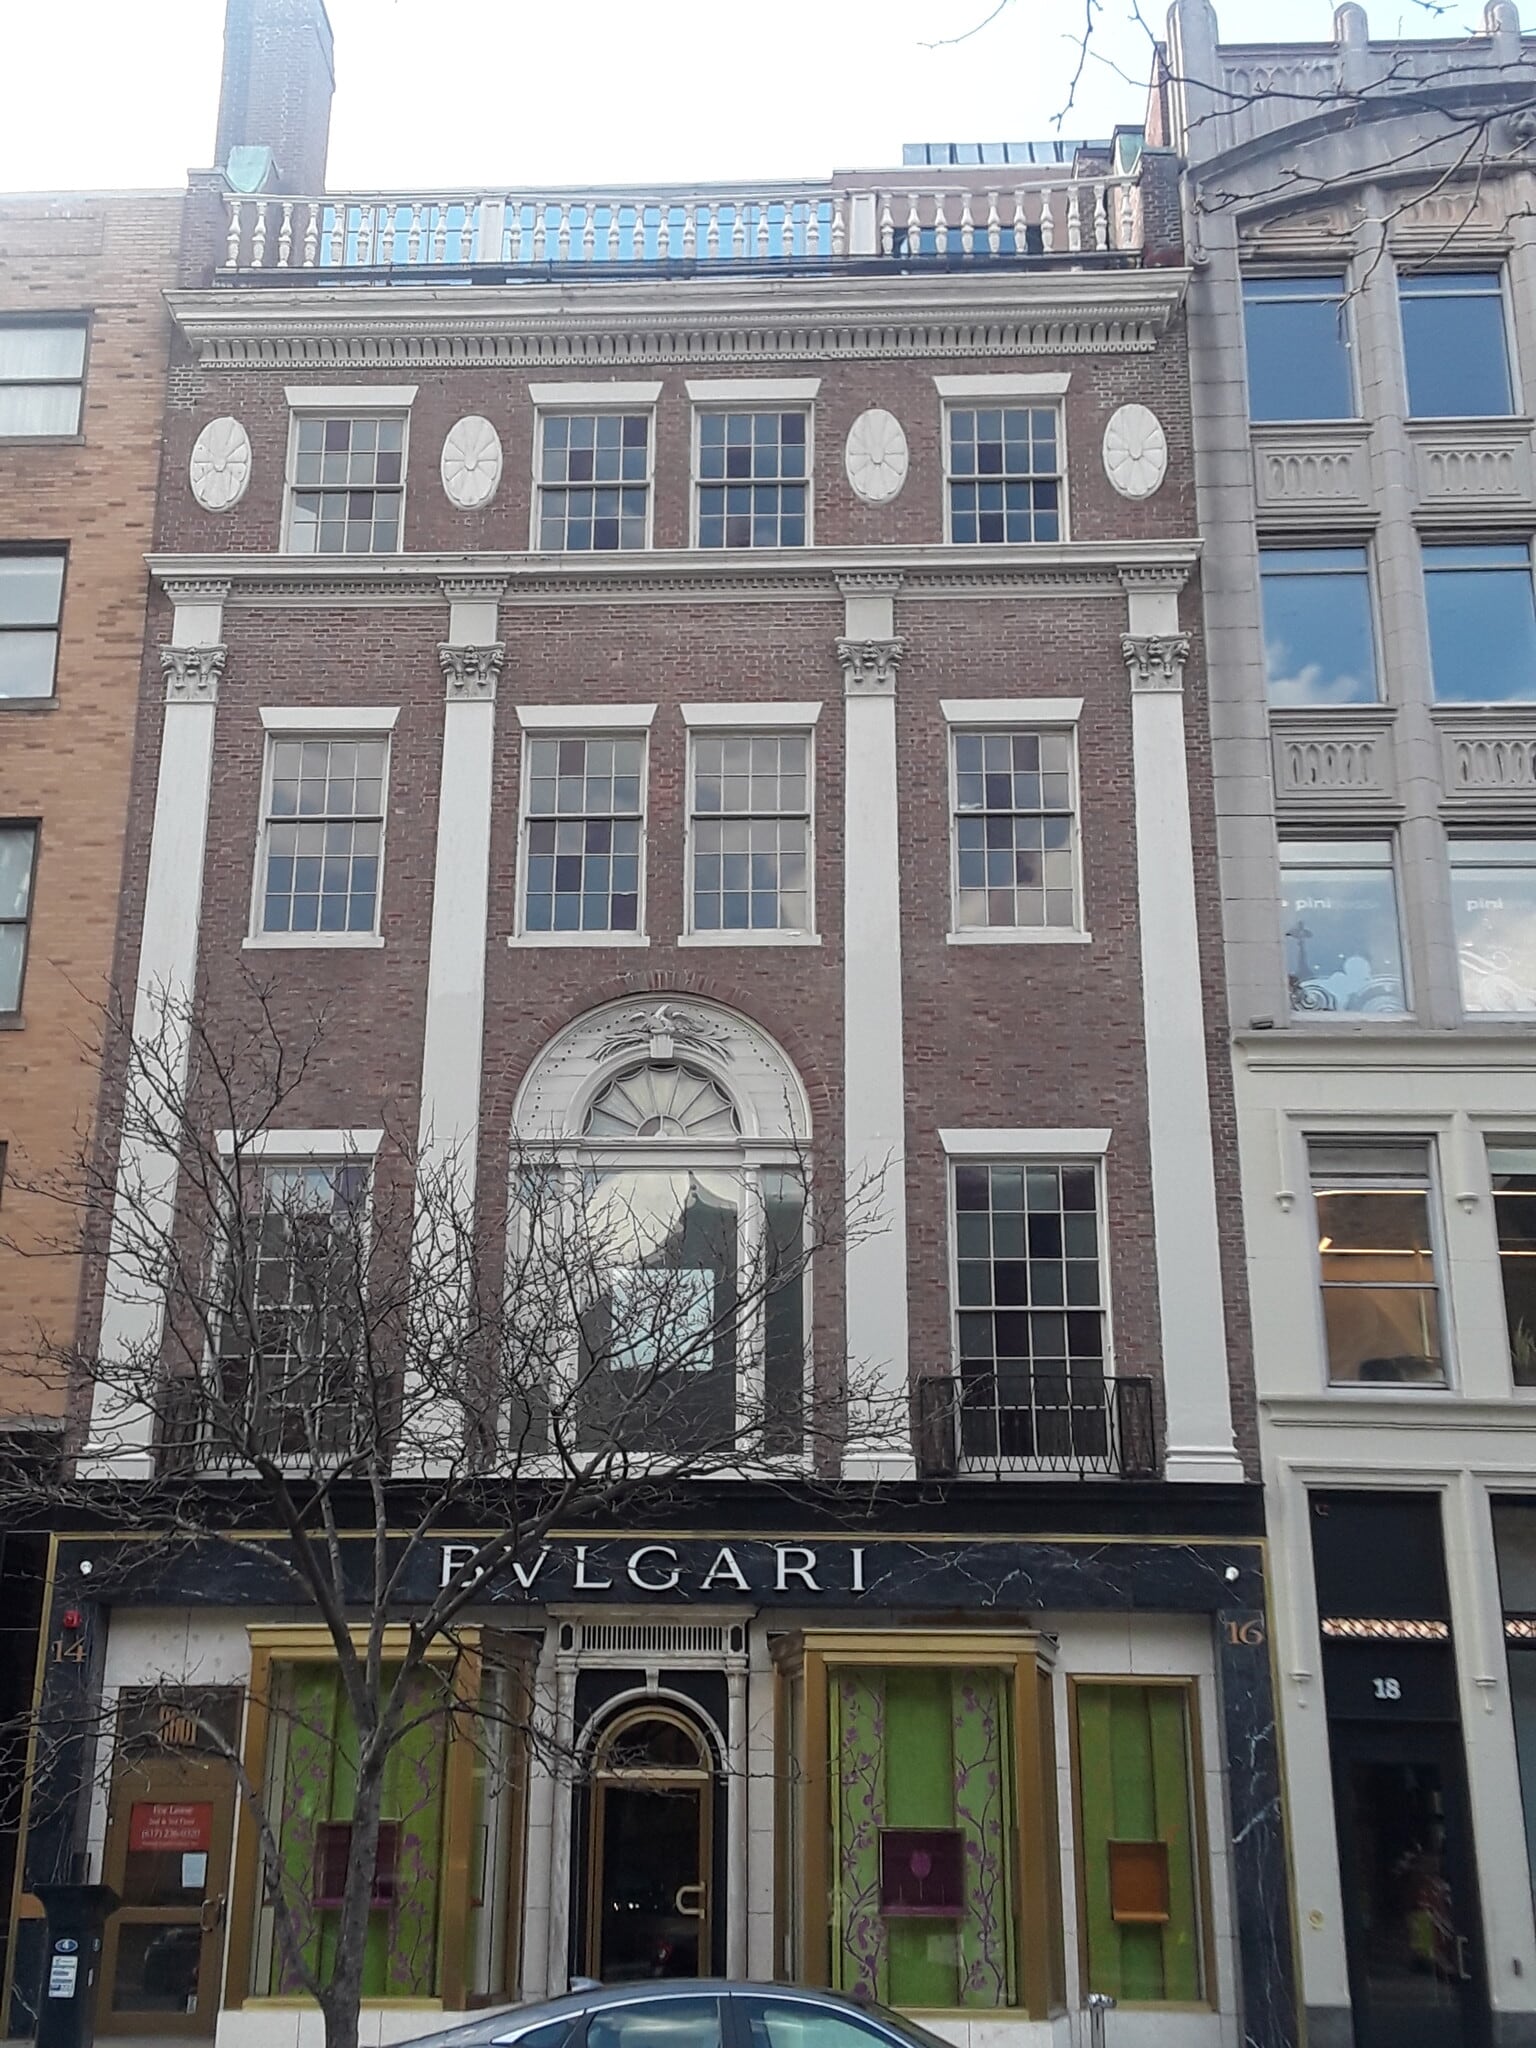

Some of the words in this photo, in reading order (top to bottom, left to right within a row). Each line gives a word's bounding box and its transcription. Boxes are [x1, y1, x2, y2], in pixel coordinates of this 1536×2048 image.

[438, 1545, 867, 1592] BVLGARI
[1227, 1619, 1264, 1646] 16
[51, 1636, 88, 1664] 14
[1372, 1677, 1402, 1700] 18
